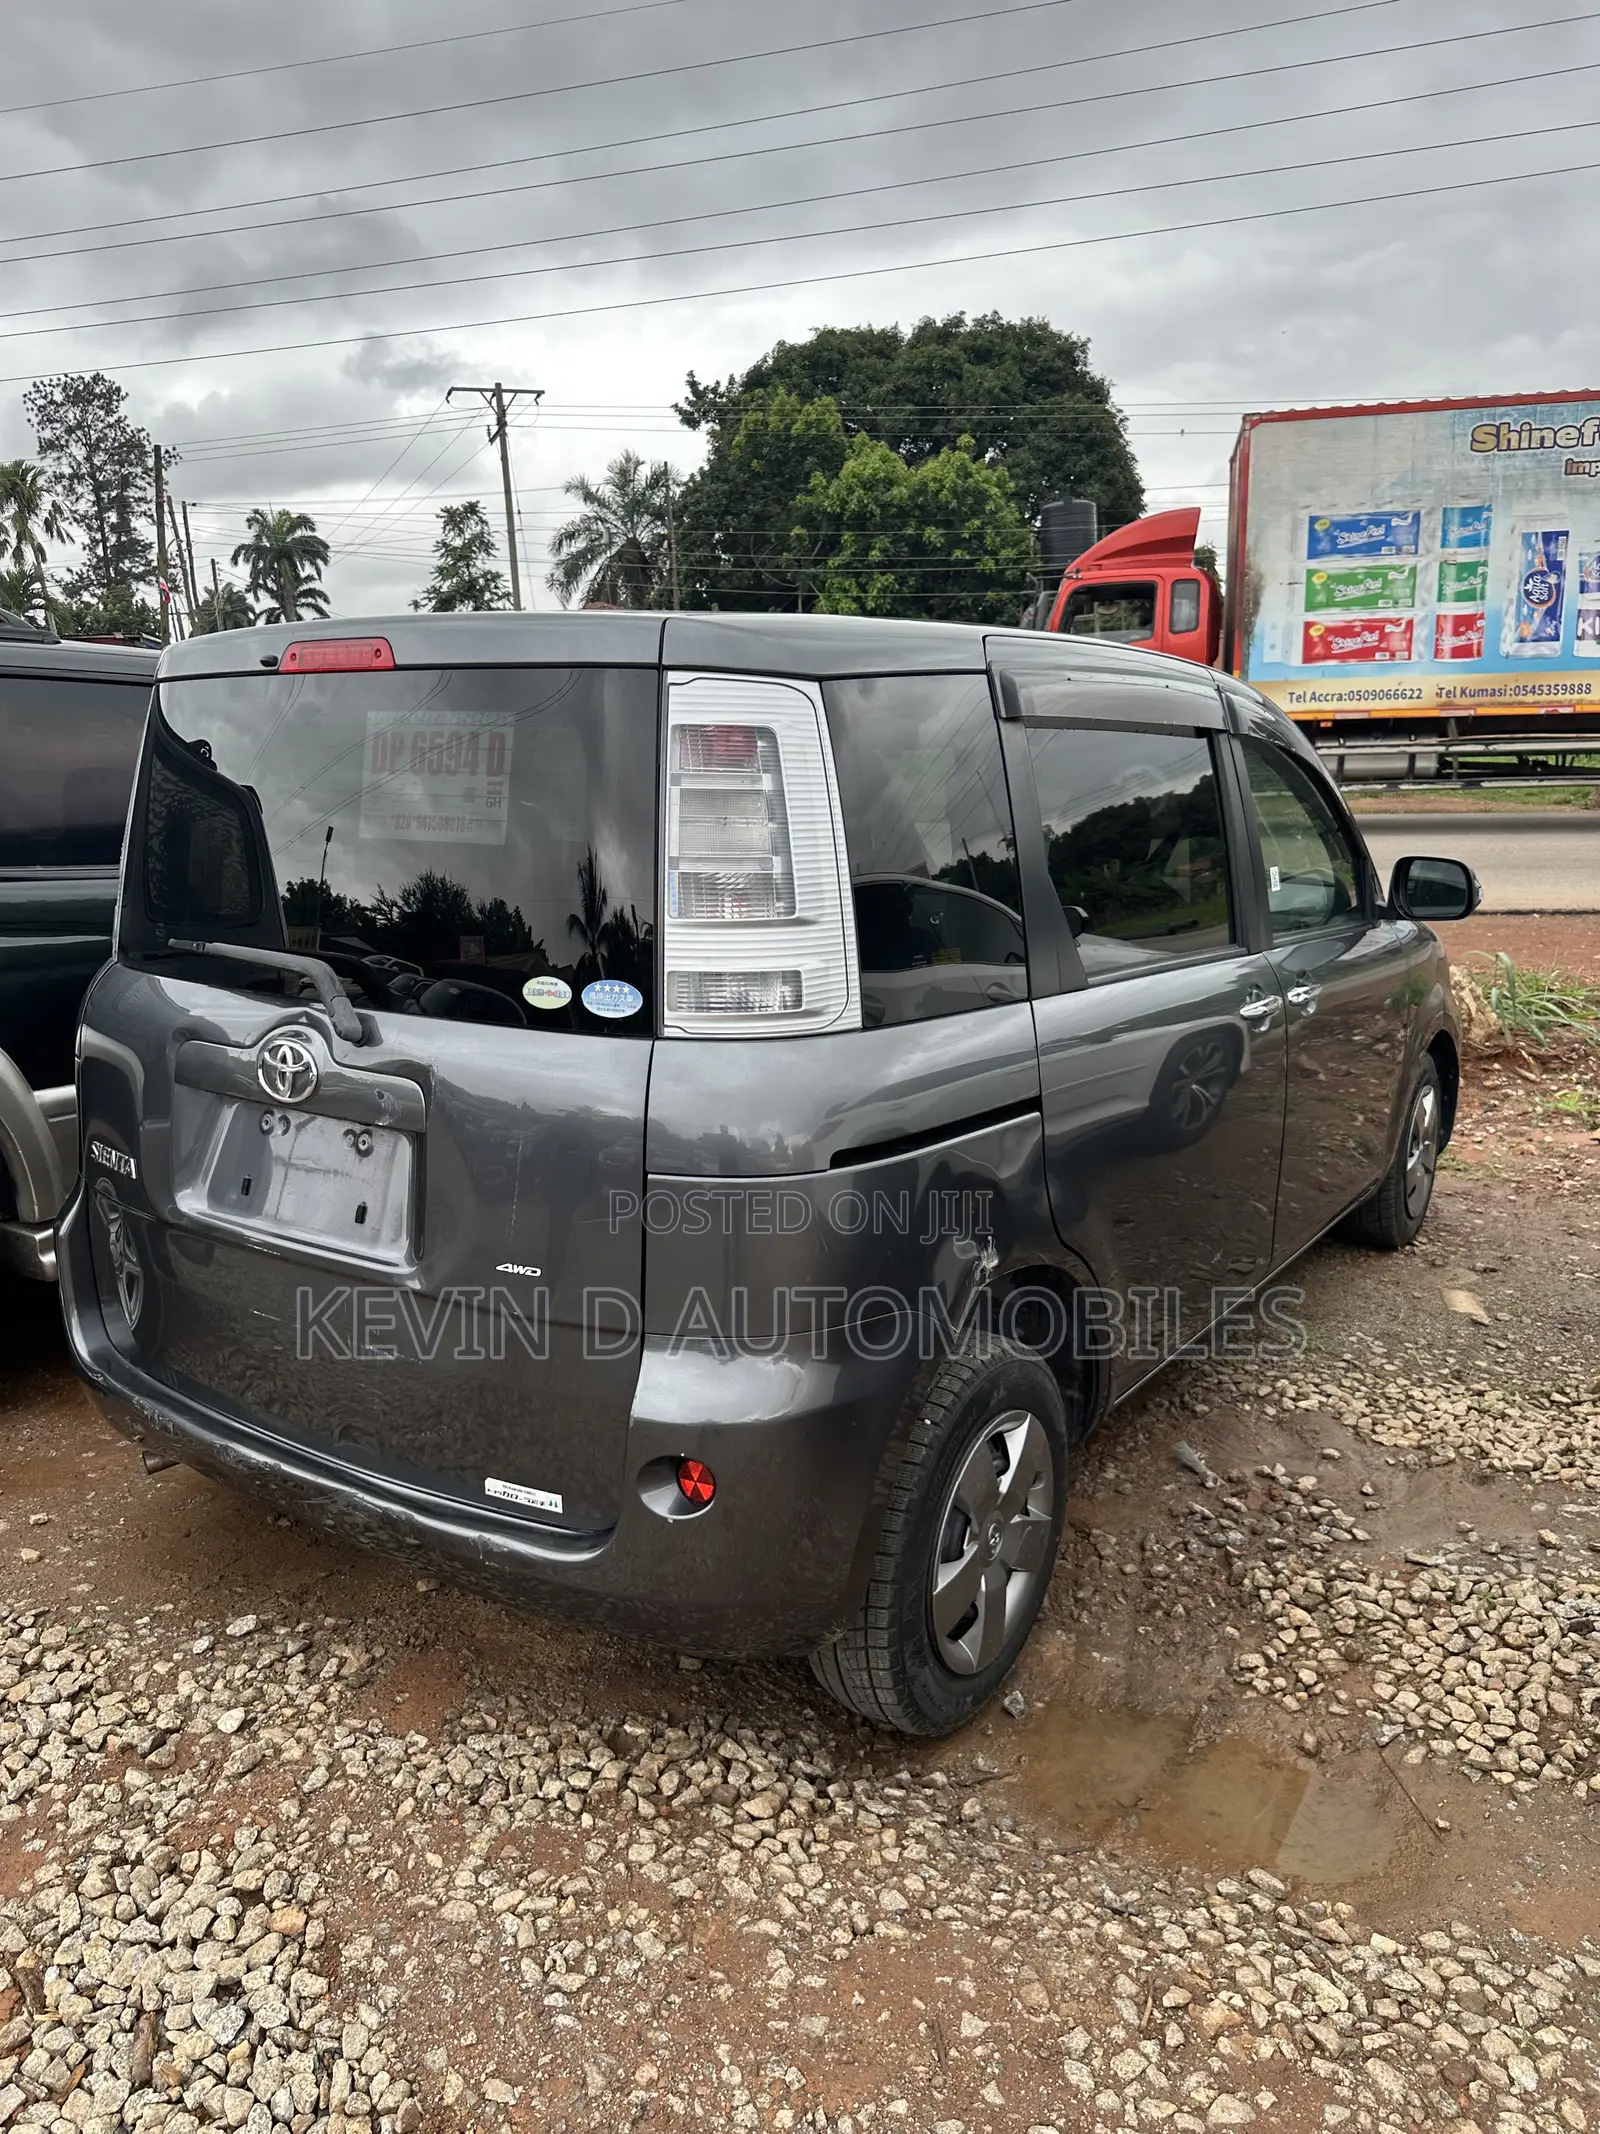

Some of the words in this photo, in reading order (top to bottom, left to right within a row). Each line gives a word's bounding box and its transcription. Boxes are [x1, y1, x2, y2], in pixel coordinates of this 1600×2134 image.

[1470, 416, 1600, 452] Shinef
[1288, 691, 1307, 703] Tel
[1309, 687, 1423, 702] Accra:0509066622
[1438, 686, 1456, 698] Tel
[371, 730, 406, 775] DP
[411, 730, 480, 777] 6594
[486, 731, 506, 777] D
[485, 797, 502, 809] GH
[91, 1140, 138, 1179] SIENTA
[495, 1263, 542, 1277] 4WD
